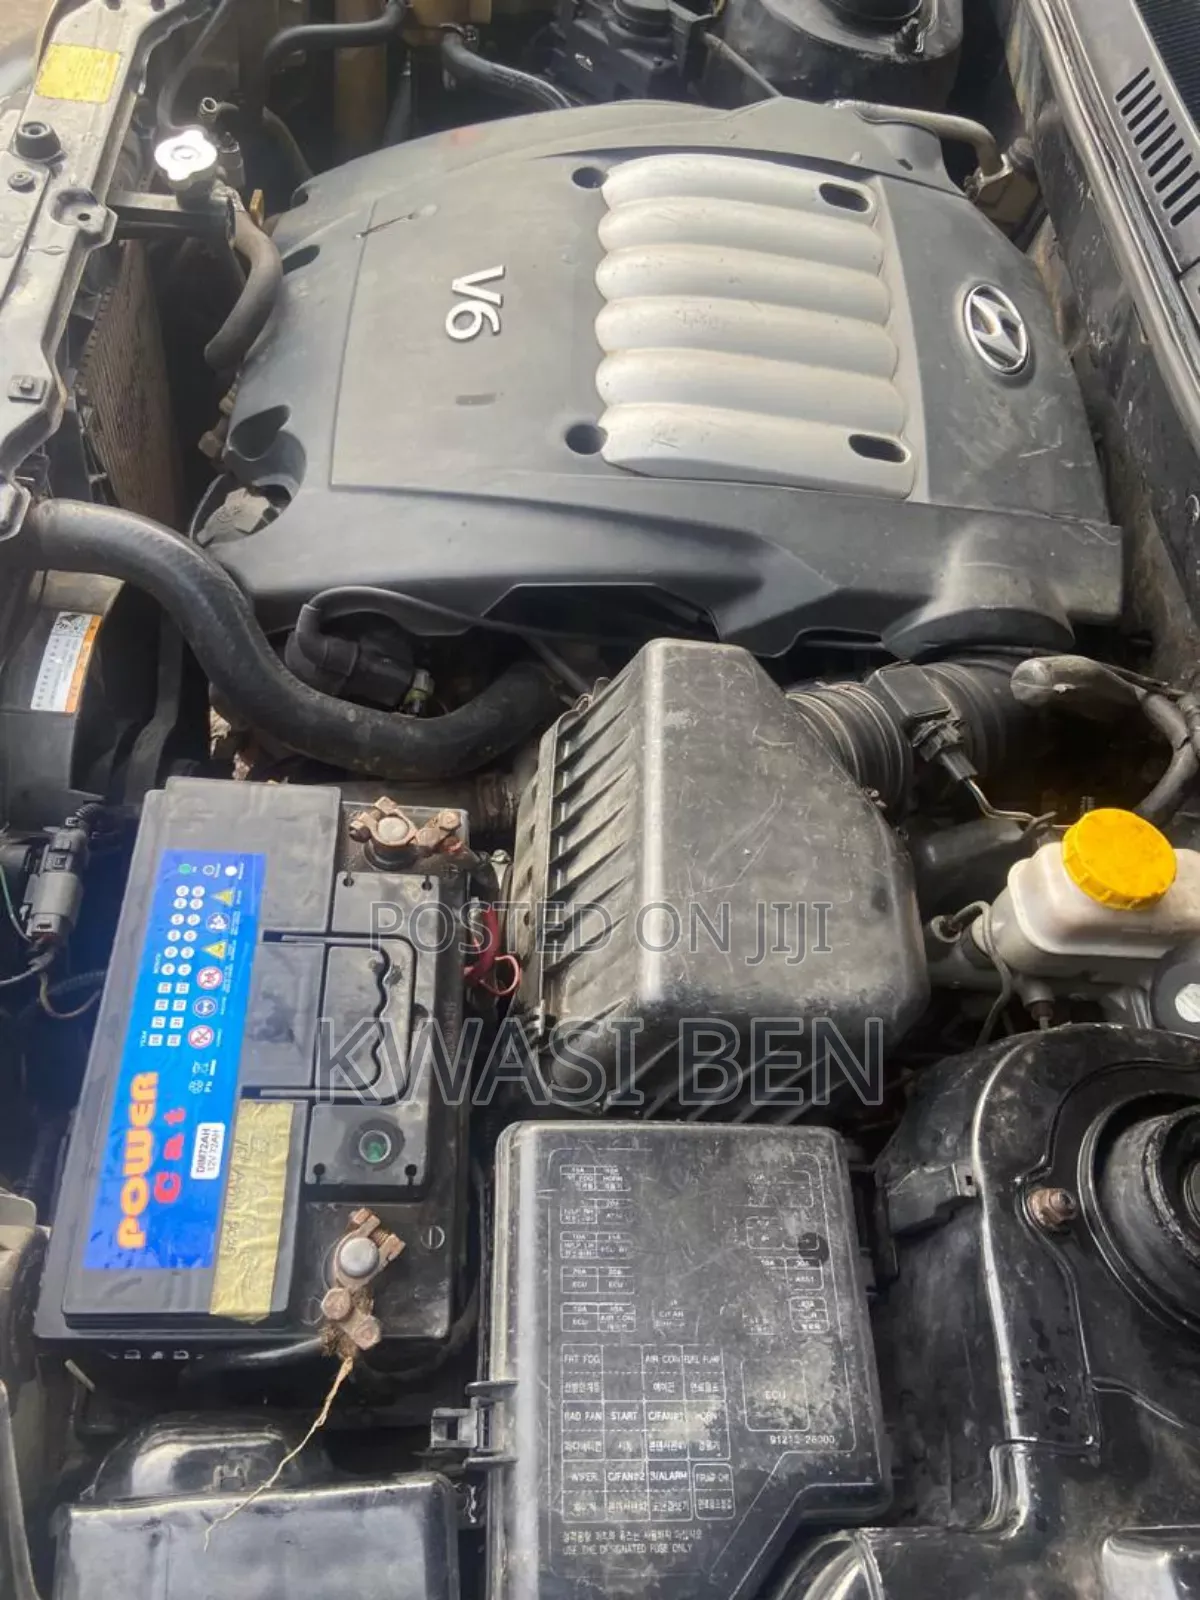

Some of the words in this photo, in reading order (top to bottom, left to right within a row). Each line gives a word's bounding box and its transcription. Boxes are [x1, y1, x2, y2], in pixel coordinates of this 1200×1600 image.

[445, 265, 504, 340] V6
[117, 1071, 159, 1249] POWER
[153, 1107, 186, 1204] Cat
[583, 1355, 600, 1364] FOG
[645, 1355, 659, 1364] AIR
[662, 1355, 681, 1364] CON
[585, 1412, 603, 1422] FAN
[610, 1412, 638, 1422] START
